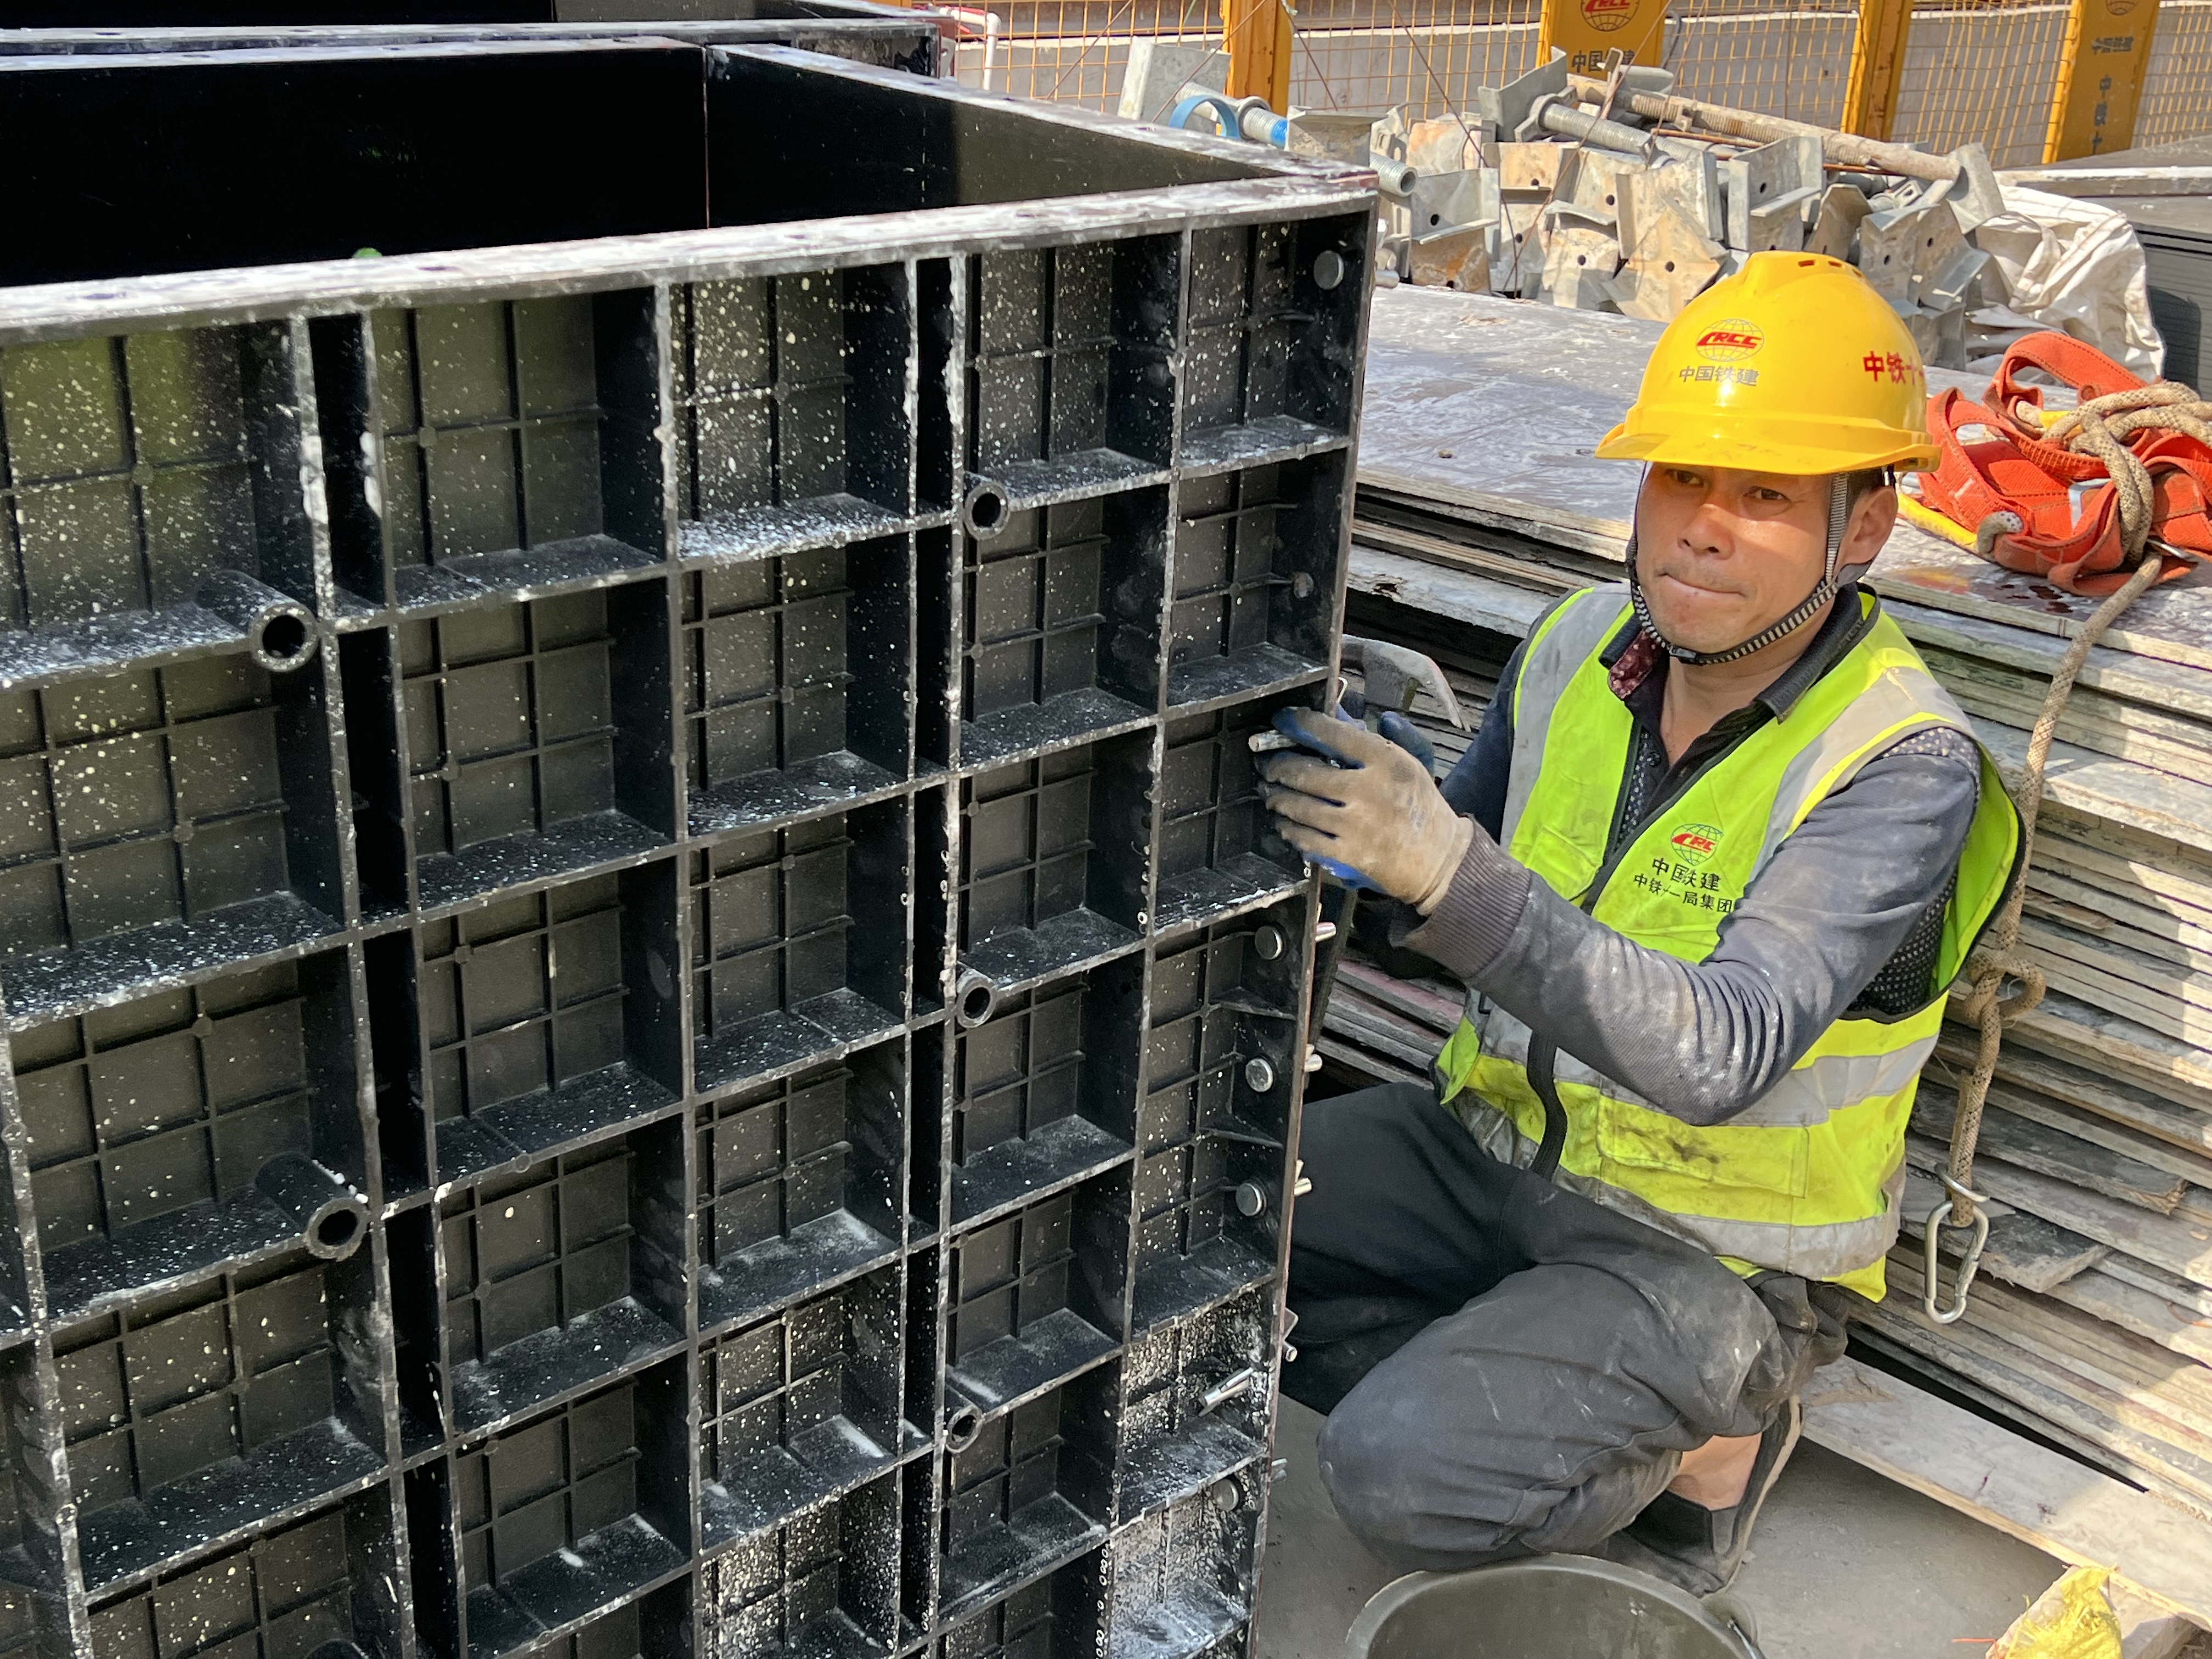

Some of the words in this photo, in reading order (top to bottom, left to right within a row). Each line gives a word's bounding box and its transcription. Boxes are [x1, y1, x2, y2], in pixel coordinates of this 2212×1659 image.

[1572, 49, 1635, 73] 中国建
[1696, 332, 1762, 349] CRCC
[1679, 365, 1759, 387] 中国铁建
